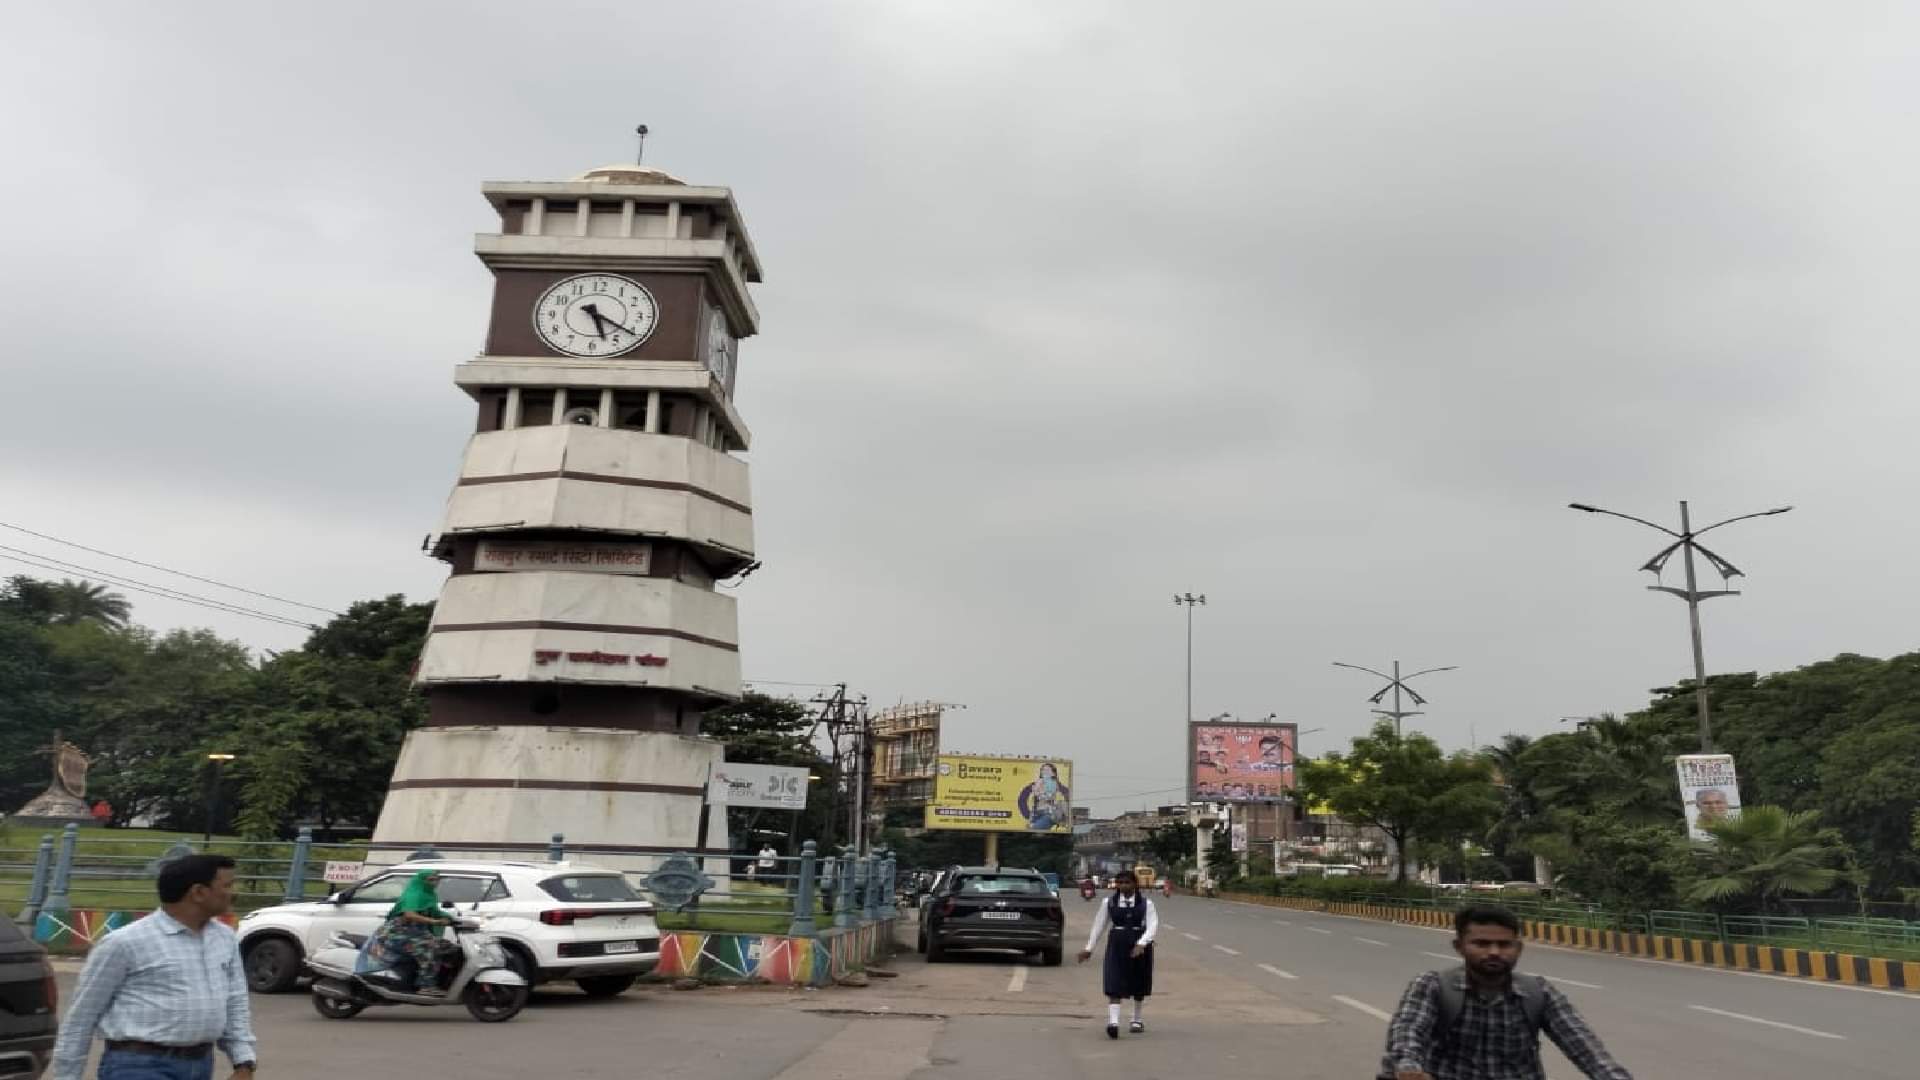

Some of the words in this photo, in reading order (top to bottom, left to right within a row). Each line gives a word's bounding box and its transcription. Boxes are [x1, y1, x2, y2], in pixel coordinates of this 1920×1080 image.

[572, 284, 583, 295] 11
[593, 281, 608, 292] 12
[556, 295, 568, 305] 10
[631, 296, 639, 307] 2
[550, 310, 556, 319] 9
[552, 324, 559, 335] 8
[588, 341, 597, 351] 6
